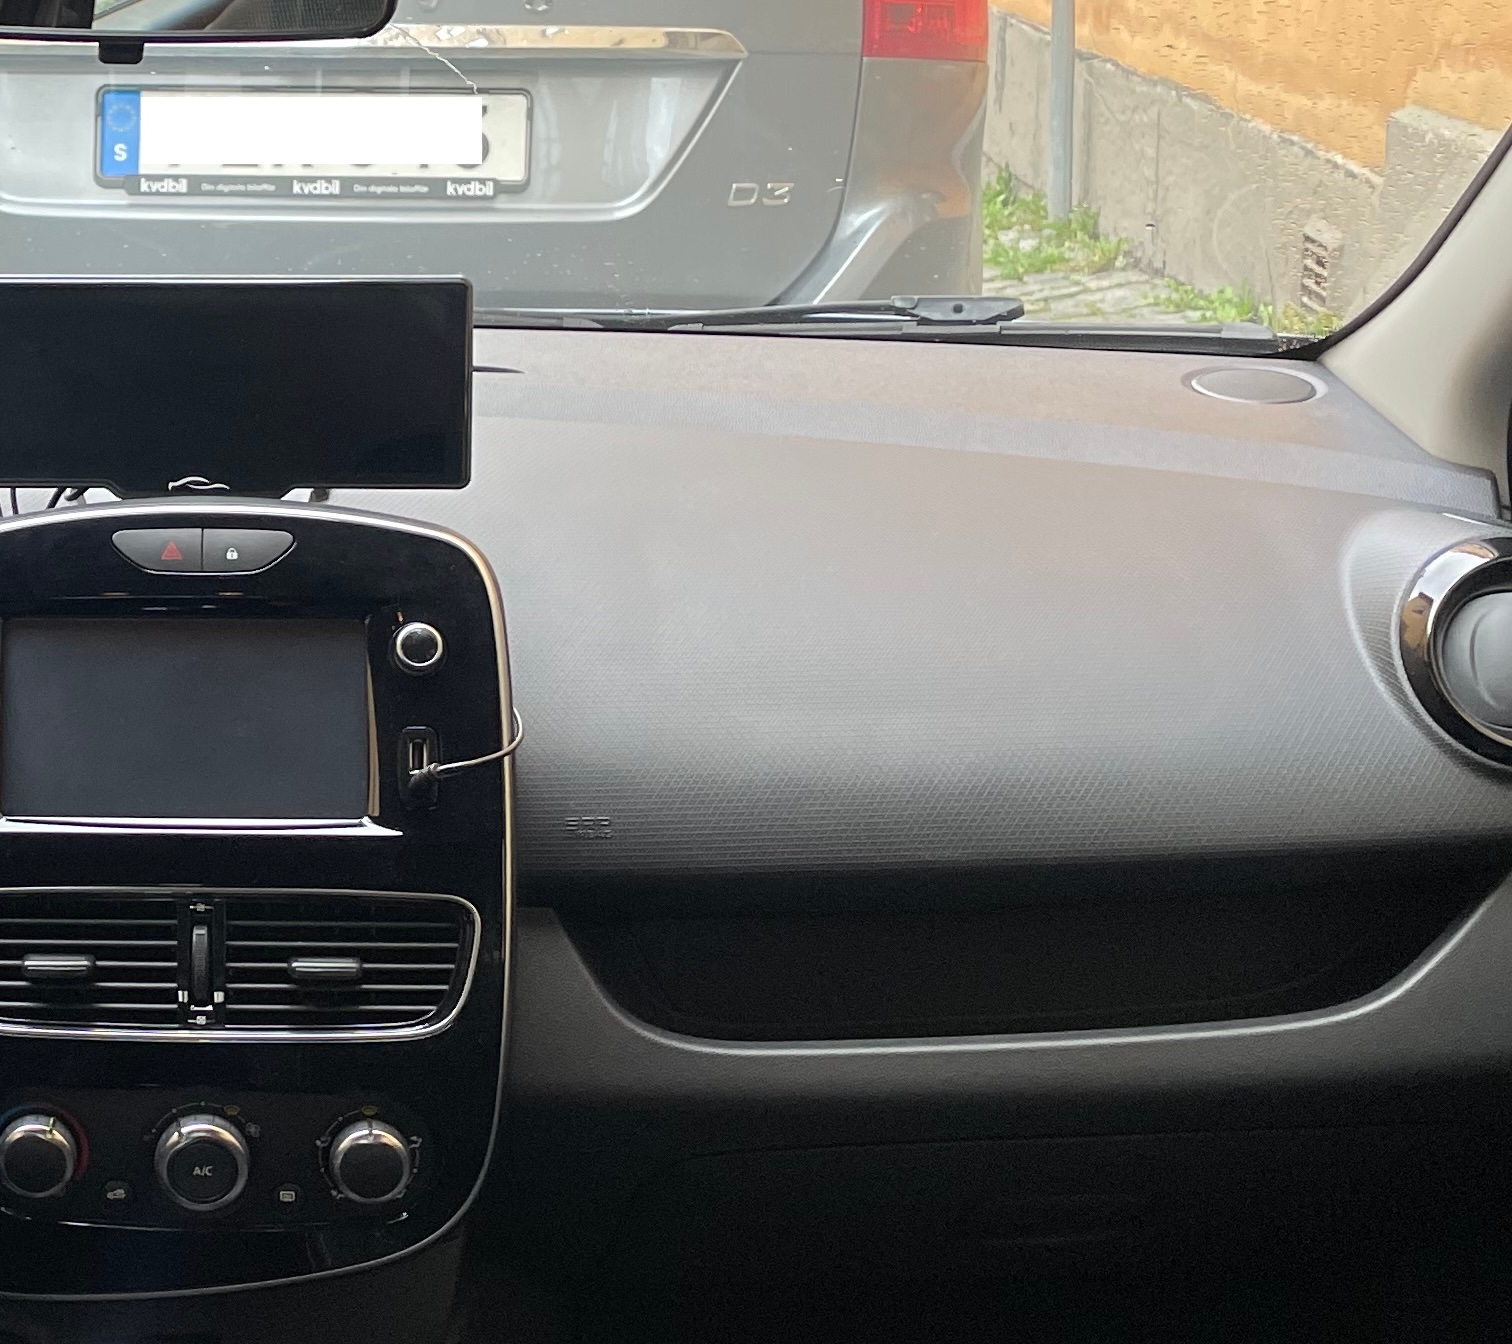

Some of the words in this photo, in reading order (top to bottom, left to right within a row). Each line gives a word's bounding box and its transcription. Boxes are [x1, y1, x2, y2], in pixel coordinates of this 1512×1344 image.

[113, 143, 128, 162] S
[139, 177, 188, 194] kvdbil
[292, 179, 341, 195] kvdbil
[445, 180, 495, 197] kvdbil
[728, 182, 795, 206] D3
[193, 1165, 214, 1176] A/C
